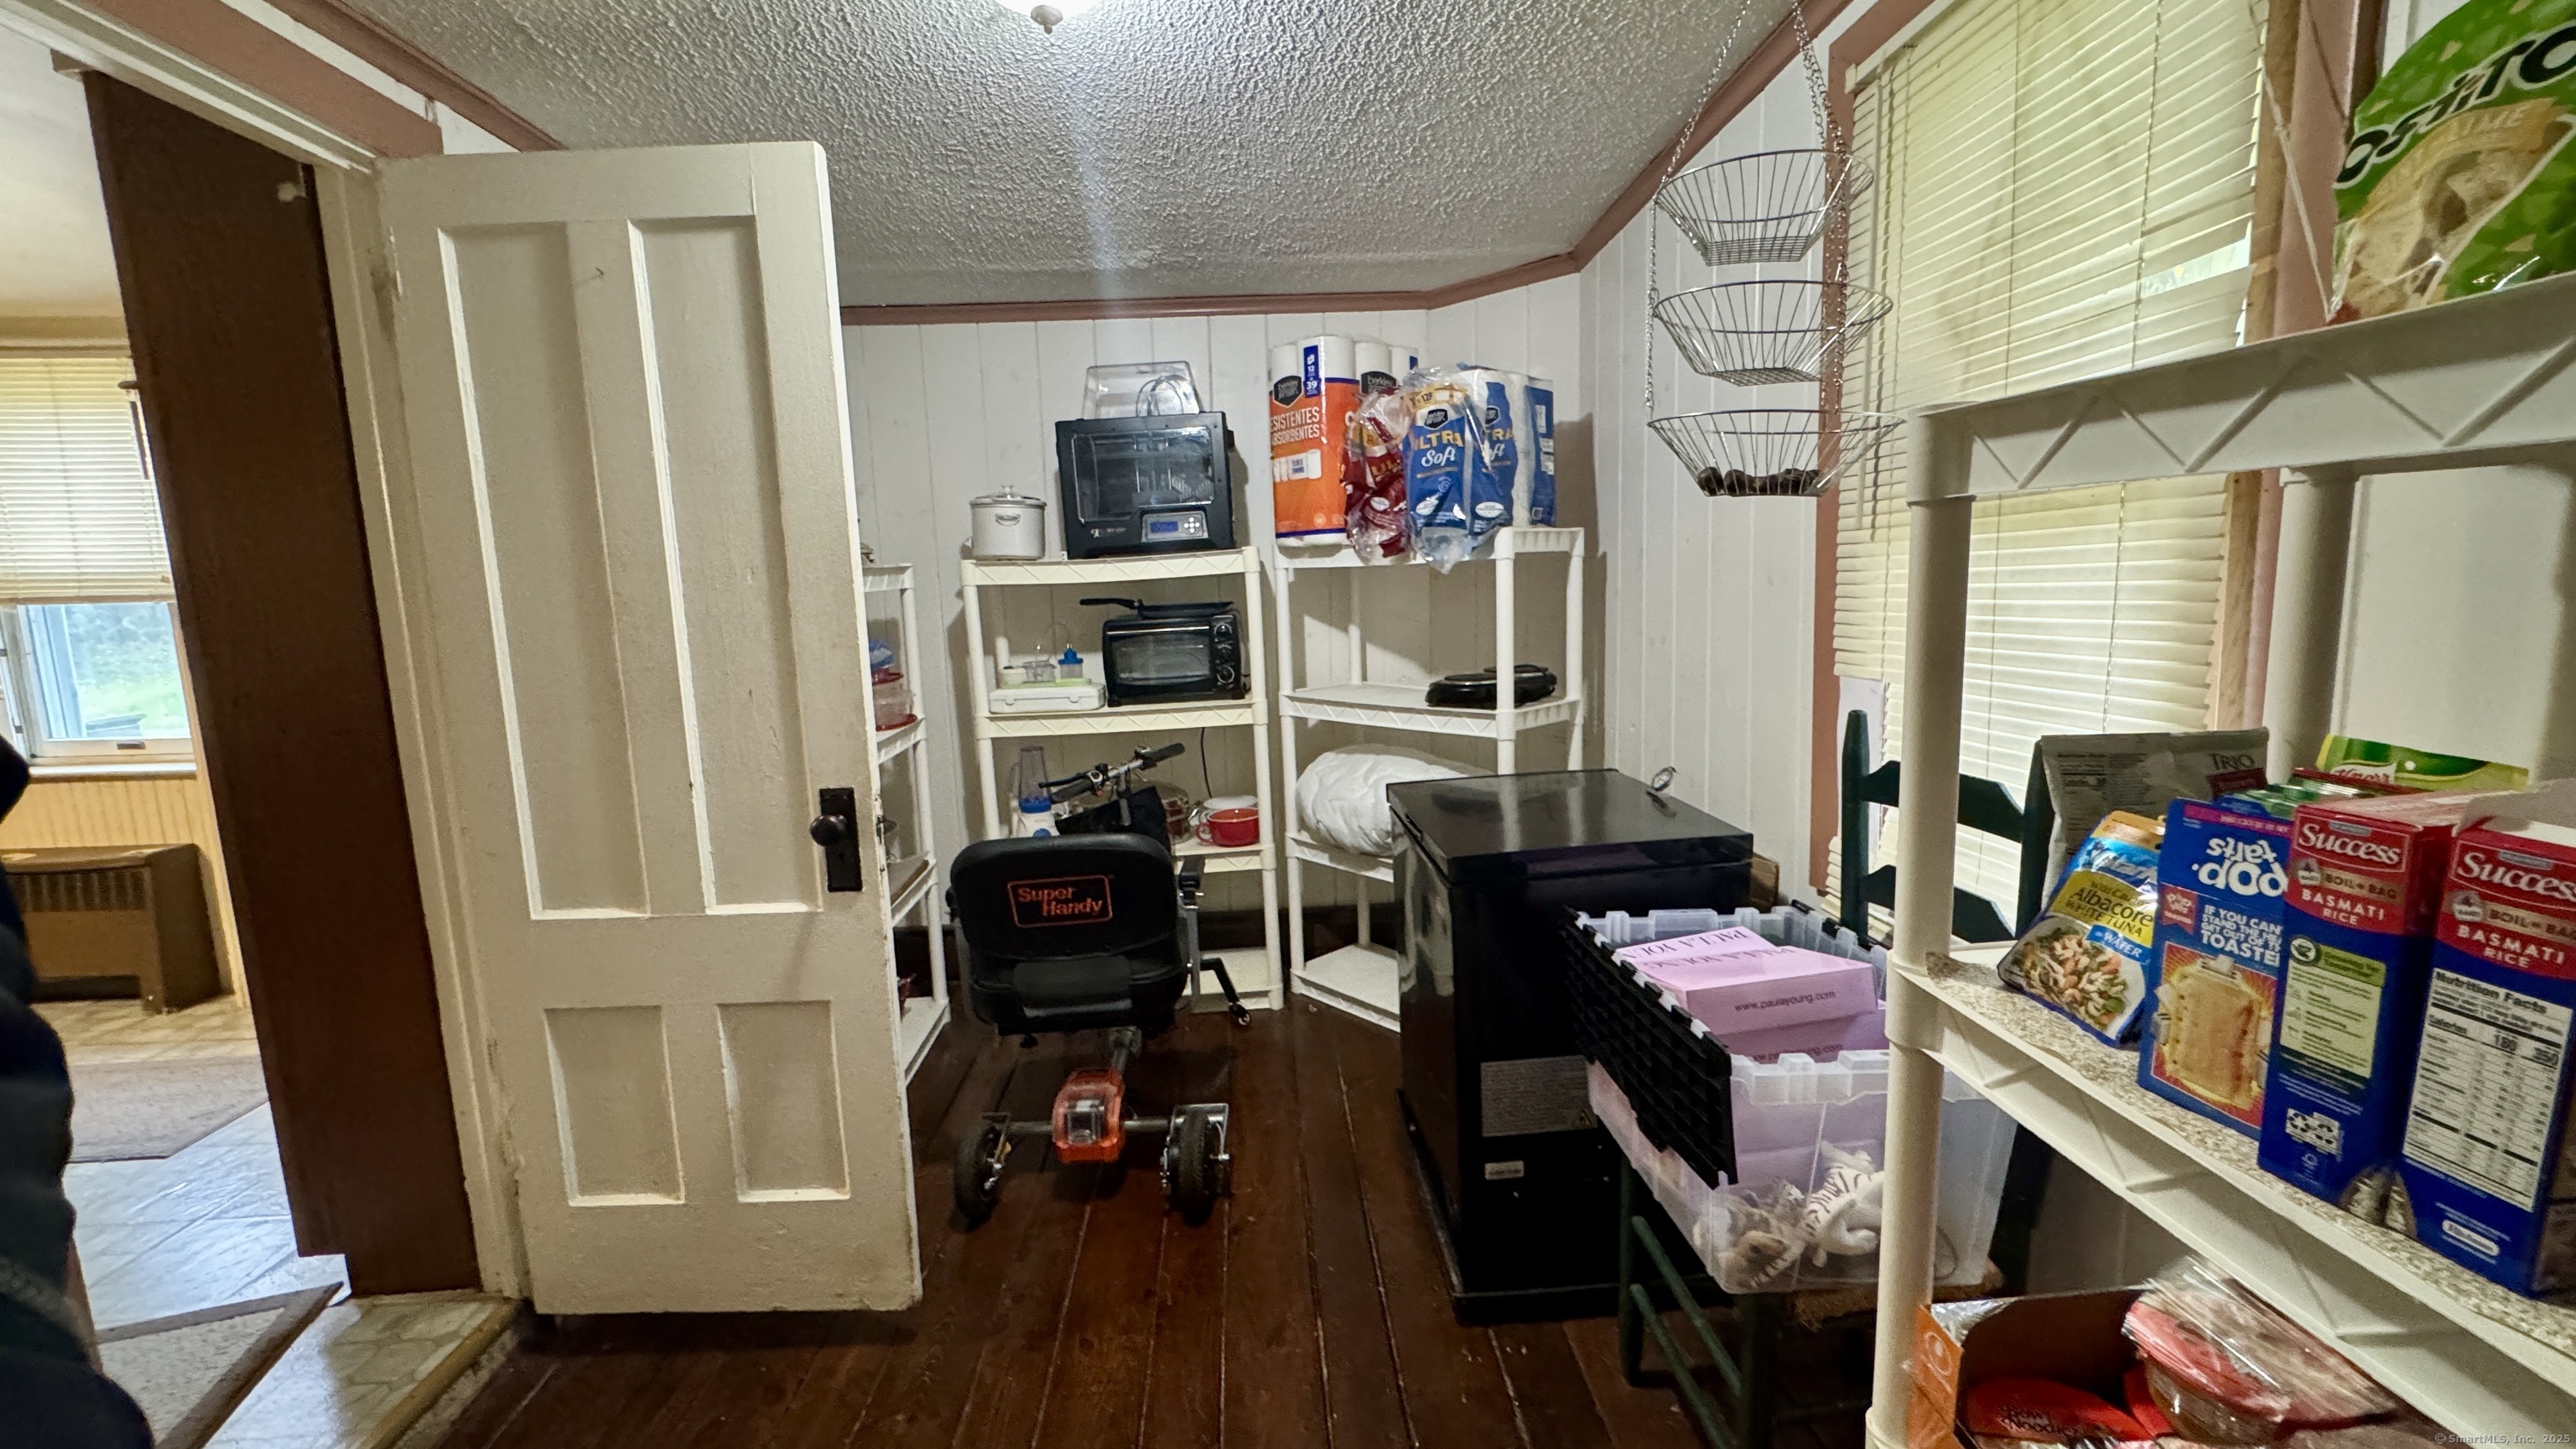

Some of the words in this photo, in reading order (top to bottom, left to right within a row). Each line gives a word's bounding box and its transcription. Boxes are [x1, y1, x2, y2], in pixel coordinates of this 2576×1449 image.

[1306, 381, 1318, 391] 39
[1420, 445, 1456, 468] Soft
[2205, 837, 2277, 864] tarts
[2298, 823, 2402, 865] Success
[1017, 886, 1074, 903] Super
[2301, 888, 2386, 922] BASMATI
[1041, 897, 1104, 917] Handy
[2070, 887, 2154, 927] Albacore
[2204, 904, 2216, 915] IF
[2218, 907, 2248, 925] YOU
[2323, 907, 2359, 927] RICE
[2107, 915, 2142, 938] TUNA
[2103, 931, 2143, 958] WATER
[2456, 924, 2566, 965] BASMATI
[2483, 946, 2532, 969] RICE
[2435, 970, 2501, 1000] Nutrition
[2503, 991, 2548, 1015] Facts
